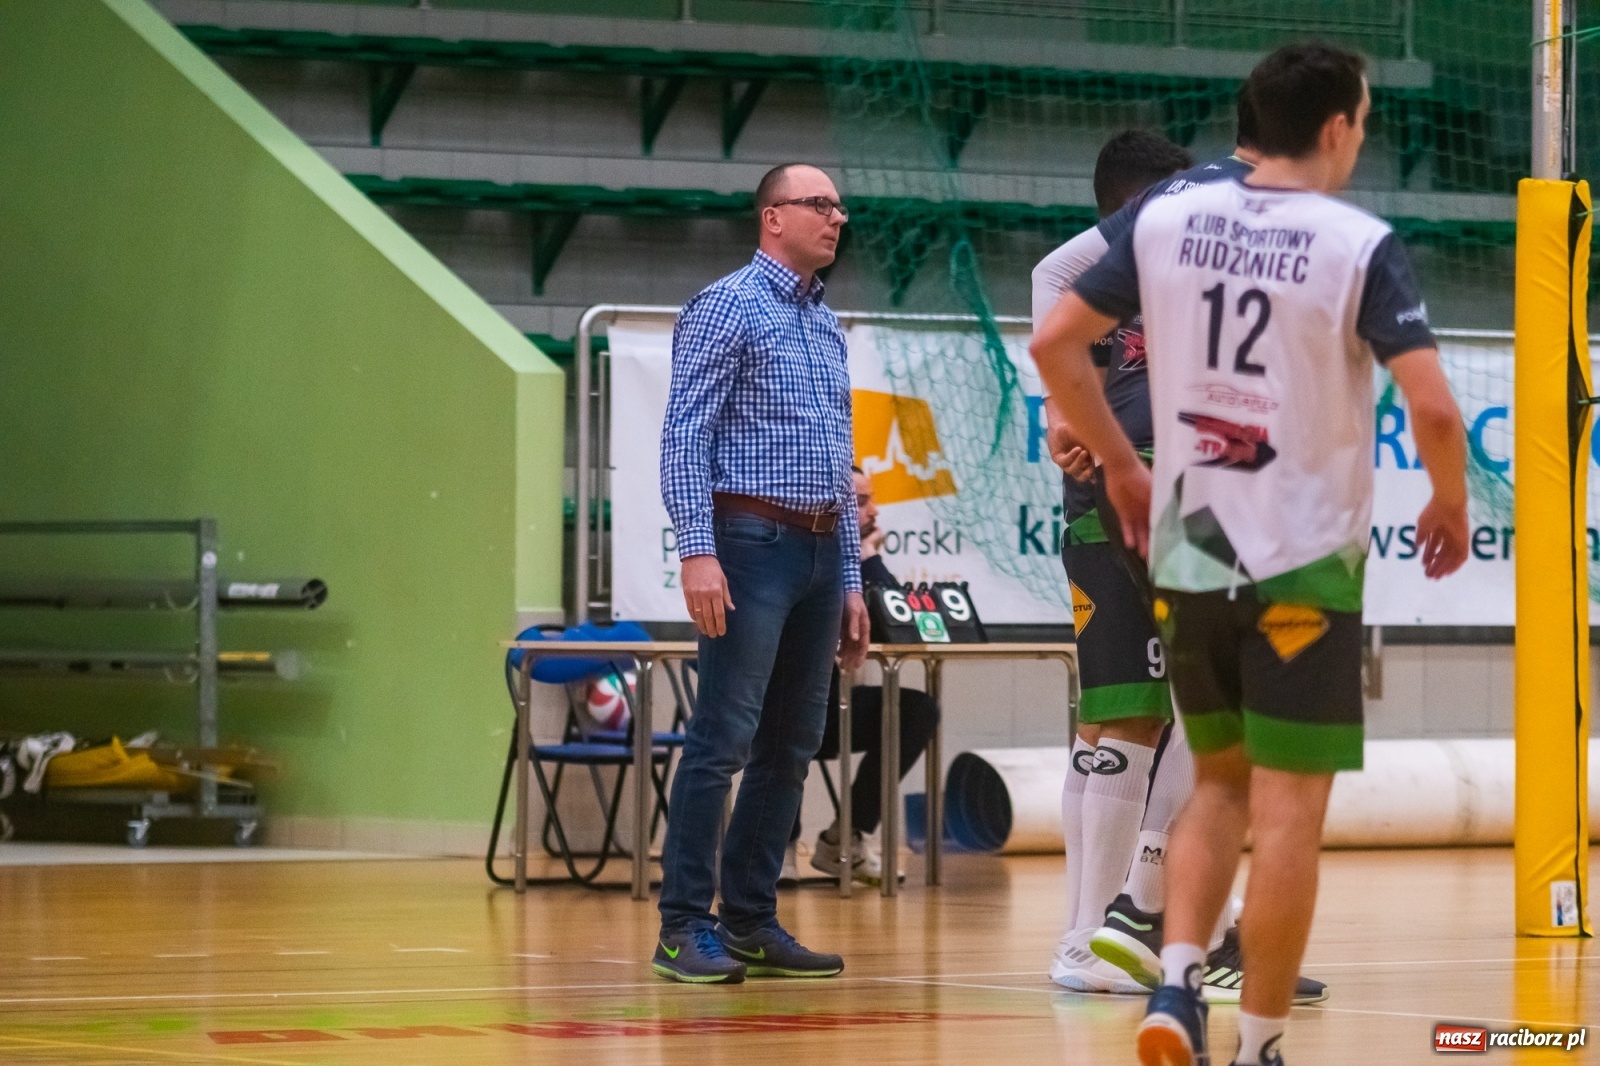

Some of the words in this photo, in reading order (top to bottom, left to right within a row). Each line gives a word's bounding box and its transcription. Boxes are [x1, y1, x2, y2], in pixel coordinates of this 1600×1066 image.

[1185, 214, 1227, 236] KLUB
[1229, 221, 1316, 252] SPORTOWY
[1202, 282, 1272, 378] 12
[885, 520, 962, 556] orski
[883, 590, 913, 622] 6
[941, 588, 971, 622] 9
[1073, 603, 1093, 613] CTUS
[1146, 637, 1166, 678] 9
